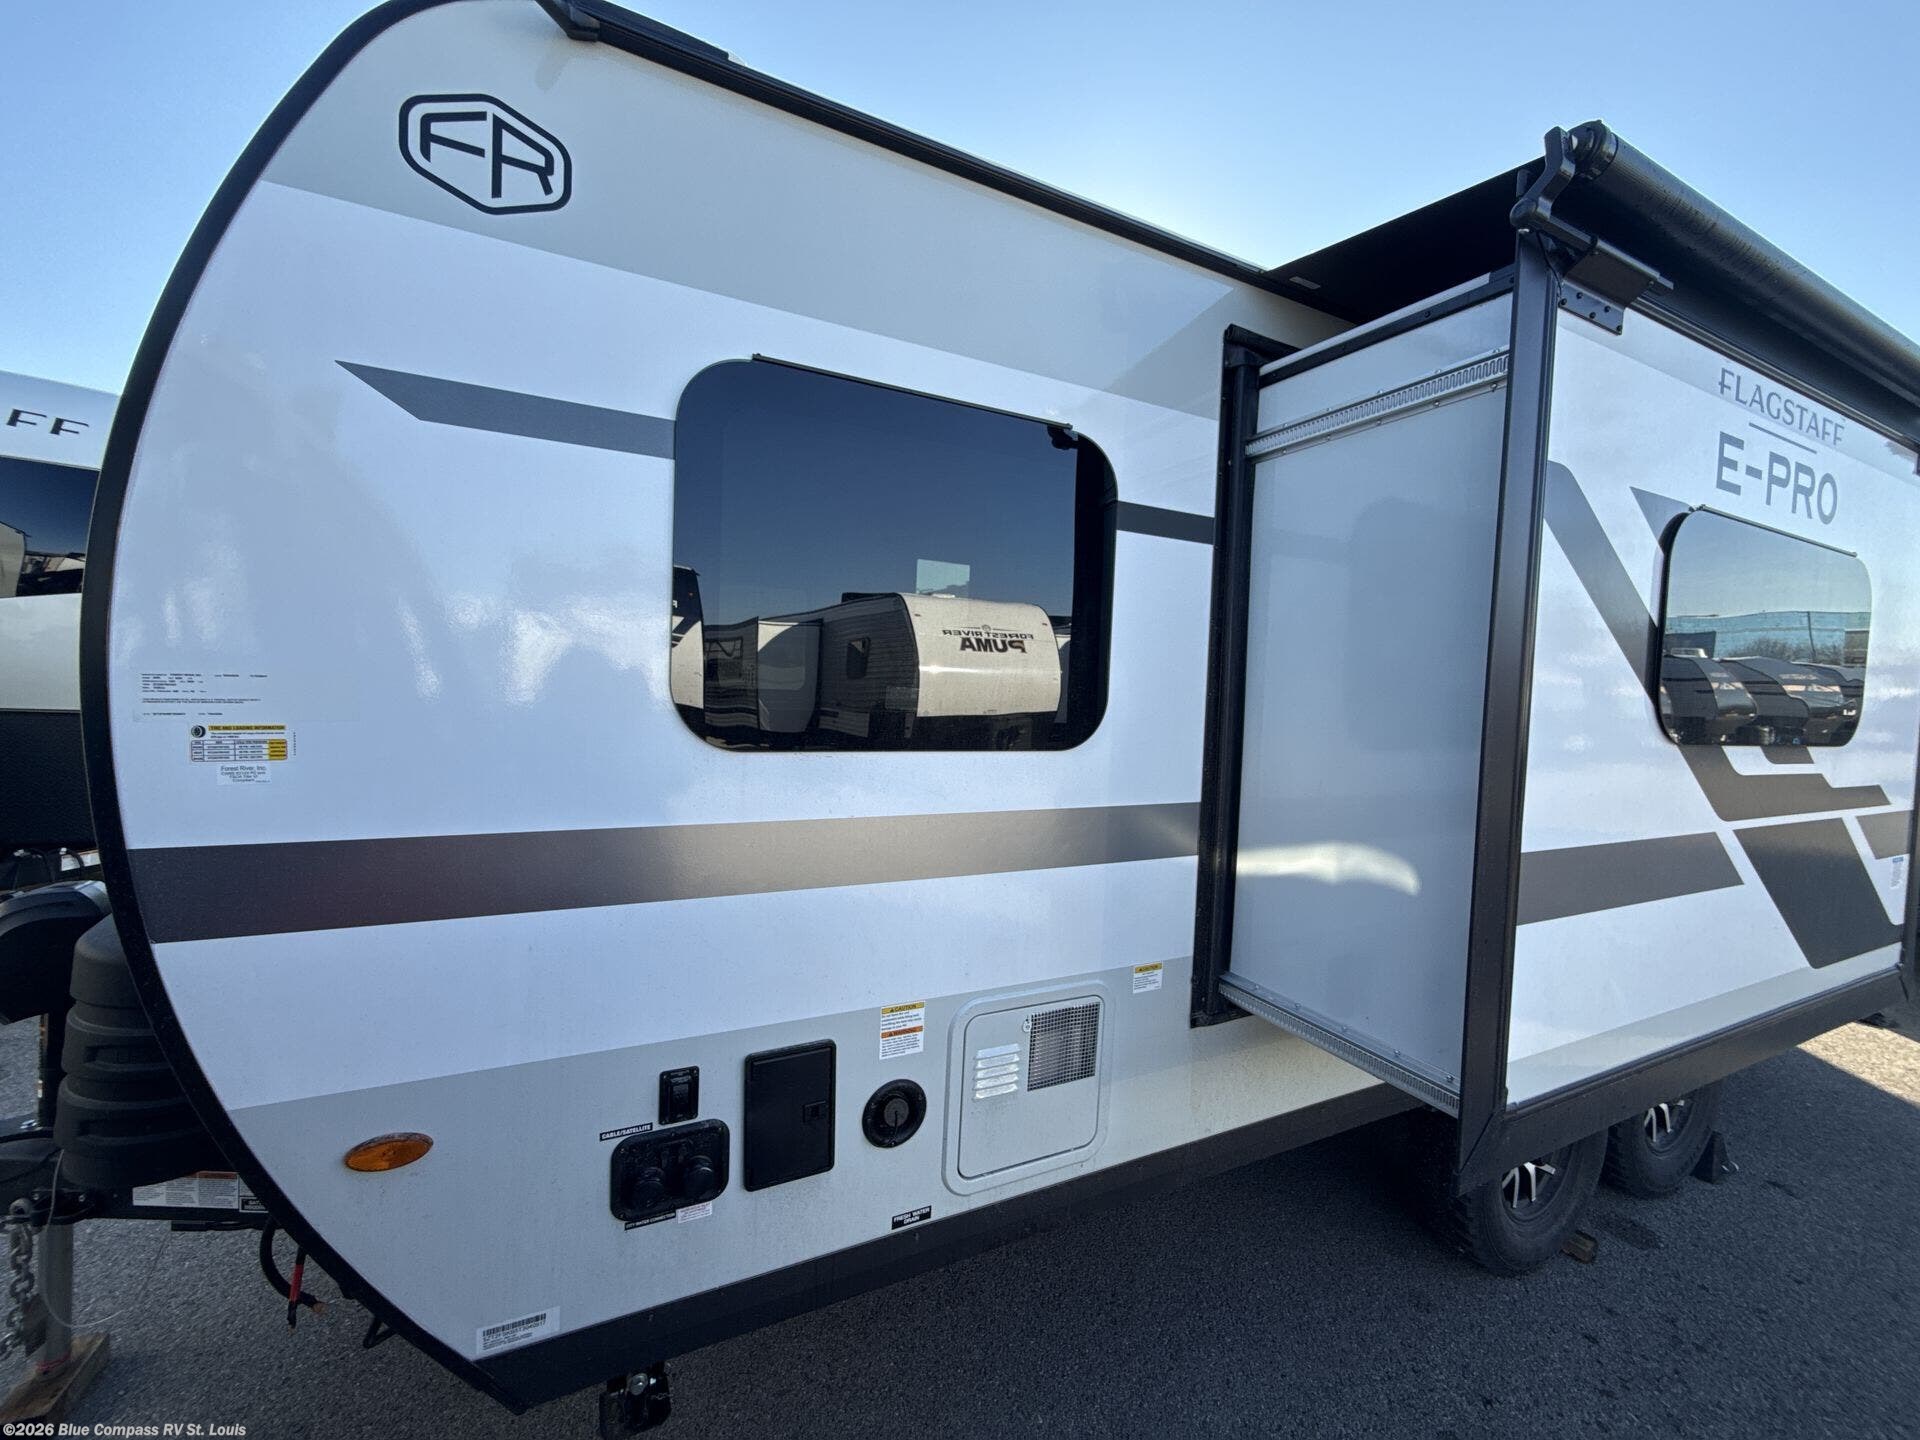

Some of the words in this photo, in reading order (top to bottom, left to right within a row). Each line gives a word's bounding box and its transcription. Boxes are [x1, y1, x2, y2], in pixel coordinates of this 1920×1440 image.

[1718, 366, 1846, 446] FLAGSTAFF
[1715, 431, 1839, 525] E-PRO
[601, 1124, 651, 1139] CABLE/SATELLITE
